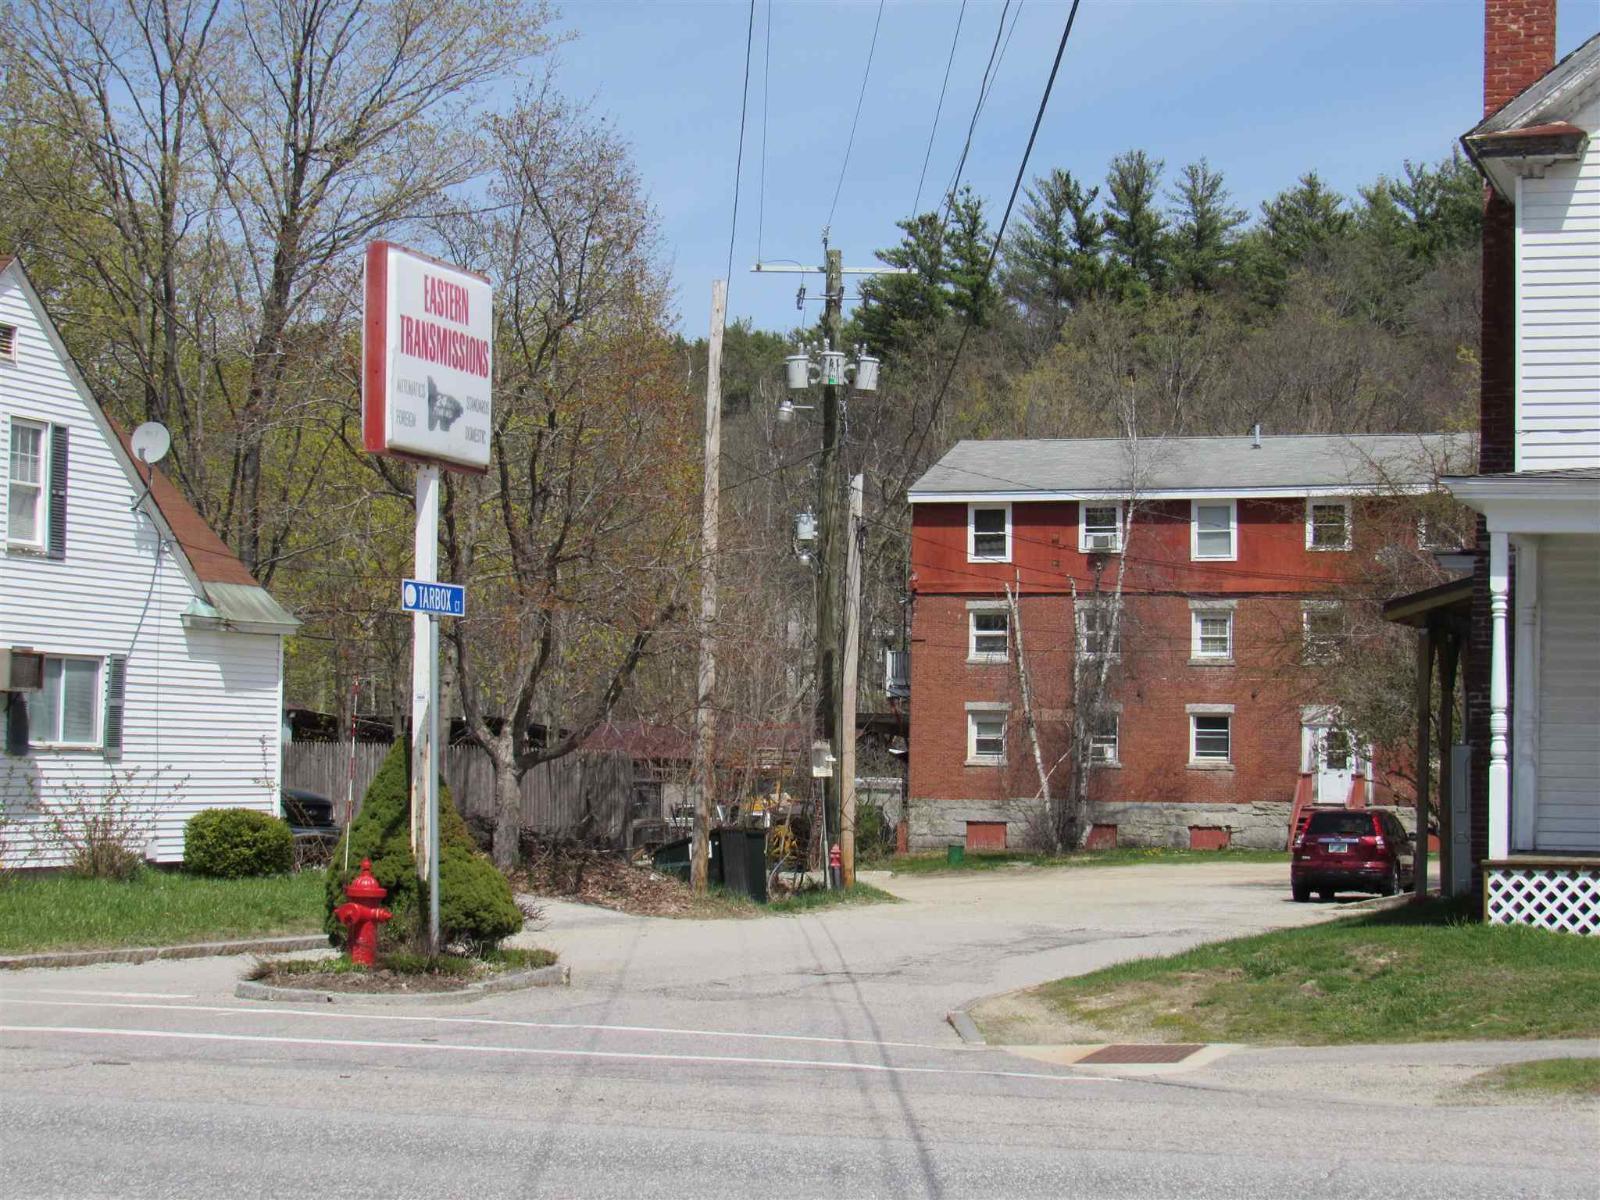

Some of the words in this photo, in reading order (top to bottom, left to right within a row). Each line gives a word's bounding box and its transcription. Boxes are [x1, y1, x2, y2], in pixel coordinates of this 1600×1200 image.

[424, 275, 469, 326] EASTERN
[400, 315, 489, 379] TRANSMISSIONS
[396, 409, 416, 427] FOREIGN
[465, 426, 486, 445] DOMESTIC
[419, 586, 451, 612] TARBOX
